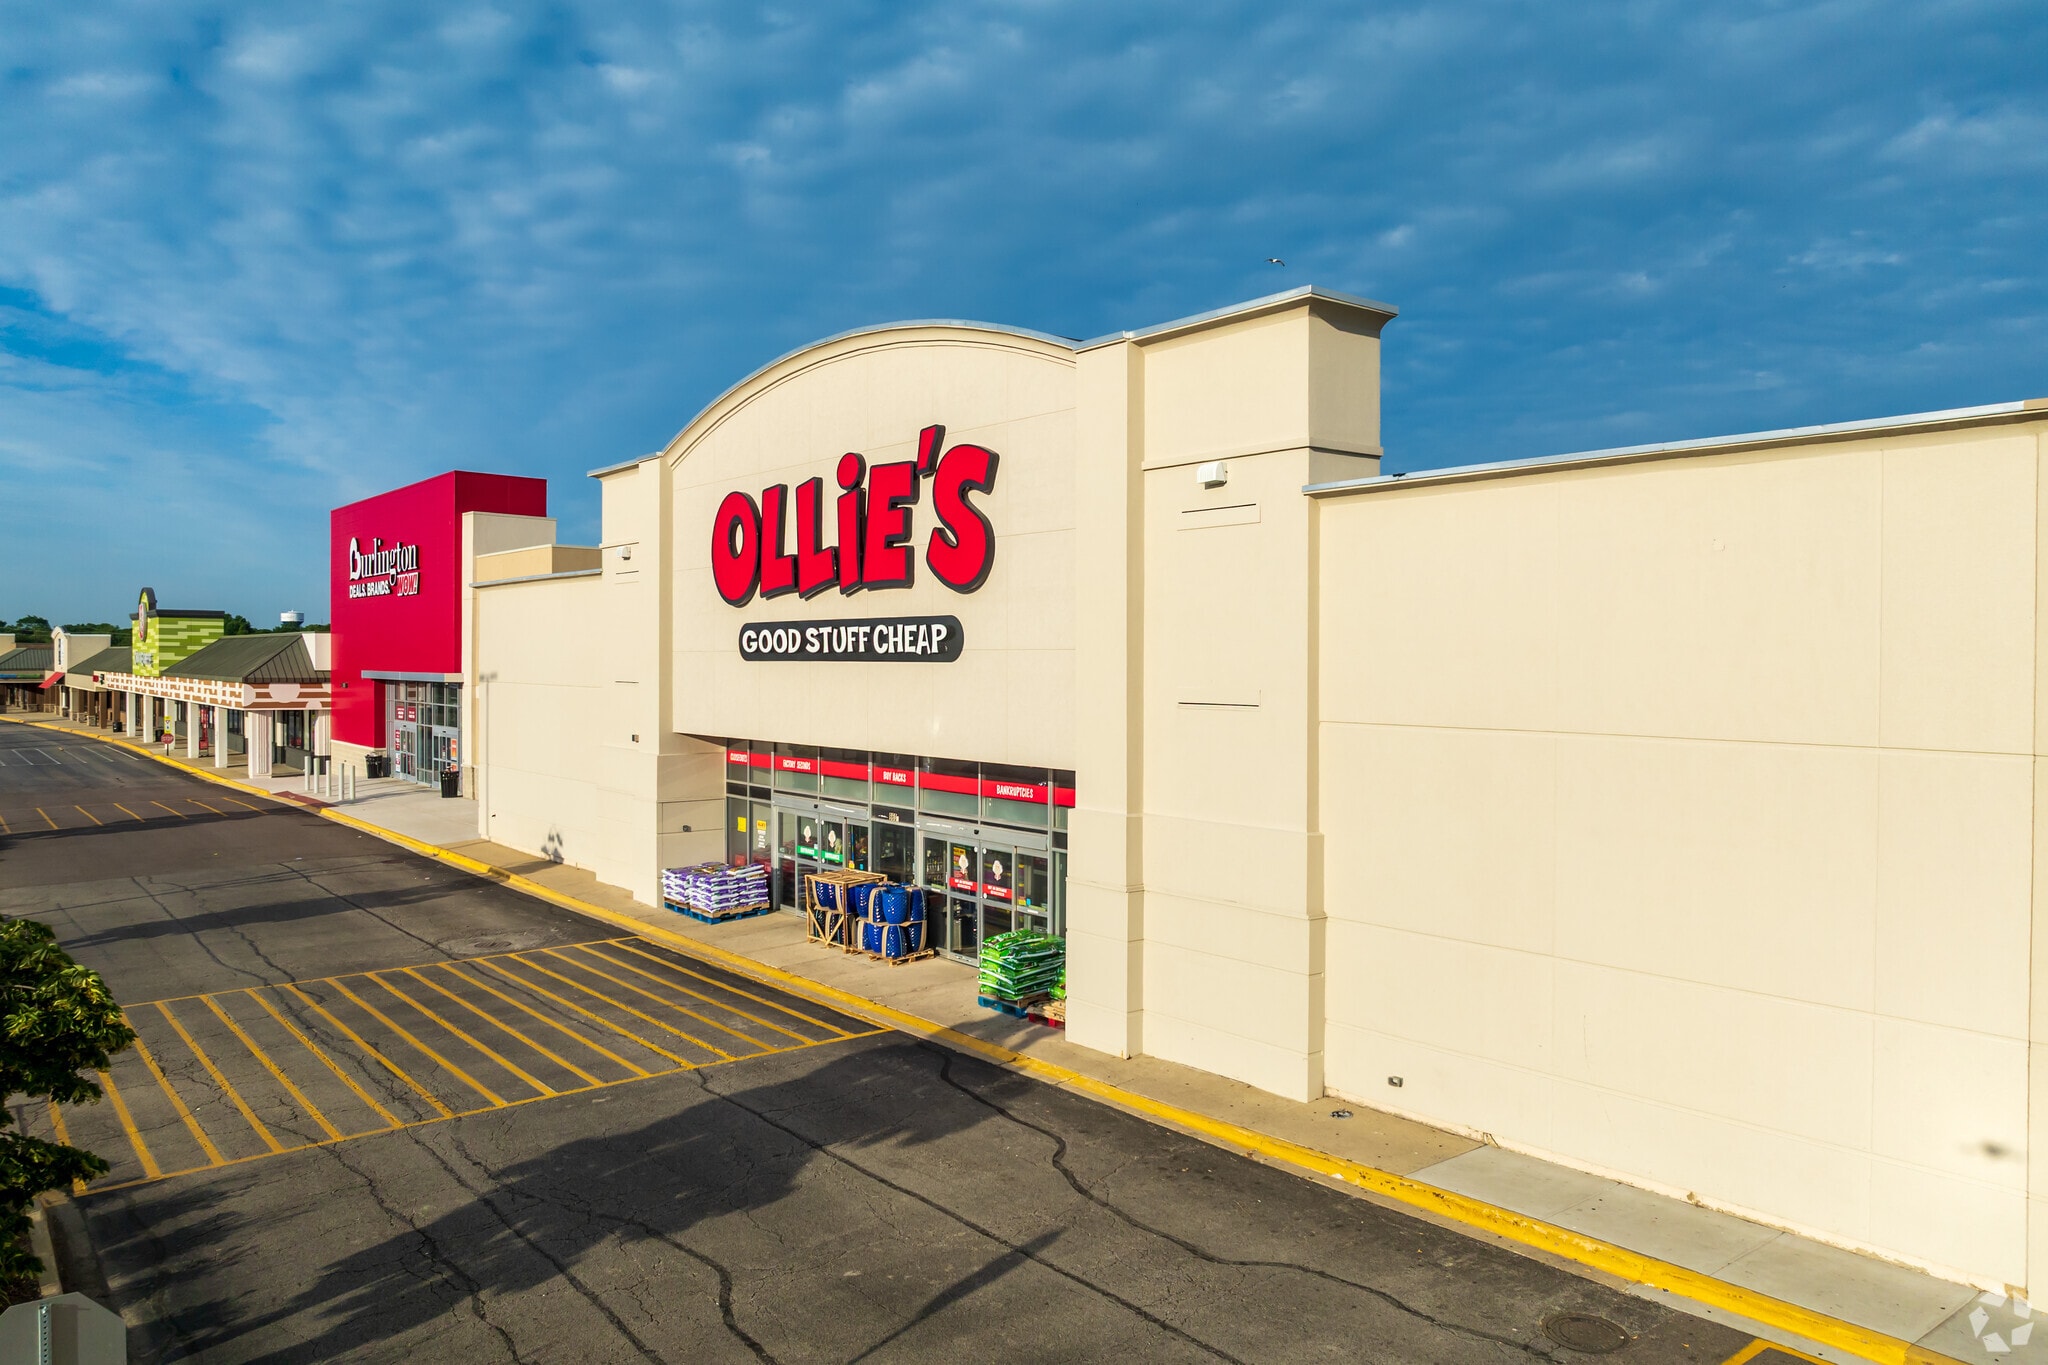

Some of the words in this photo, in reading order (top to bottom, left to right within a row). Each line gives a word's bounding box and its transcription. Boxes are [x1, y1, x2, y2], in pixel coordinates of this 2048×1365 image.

[349, 536, 418, 586] Burlington
[367, 580, 391, 597] BRANDS.
[397, 571, 419, 597] WOW!
[741, 627, 802, 654] GOOD
[805, 625, 871, 654] STUFF
[872, 623, 949, 656] CHEAP
[883, 771, 892, 781] BUY
[892, 772, 907, 783] BACKS
[996, 784, 1034, 799] BANKRUPTCIES
